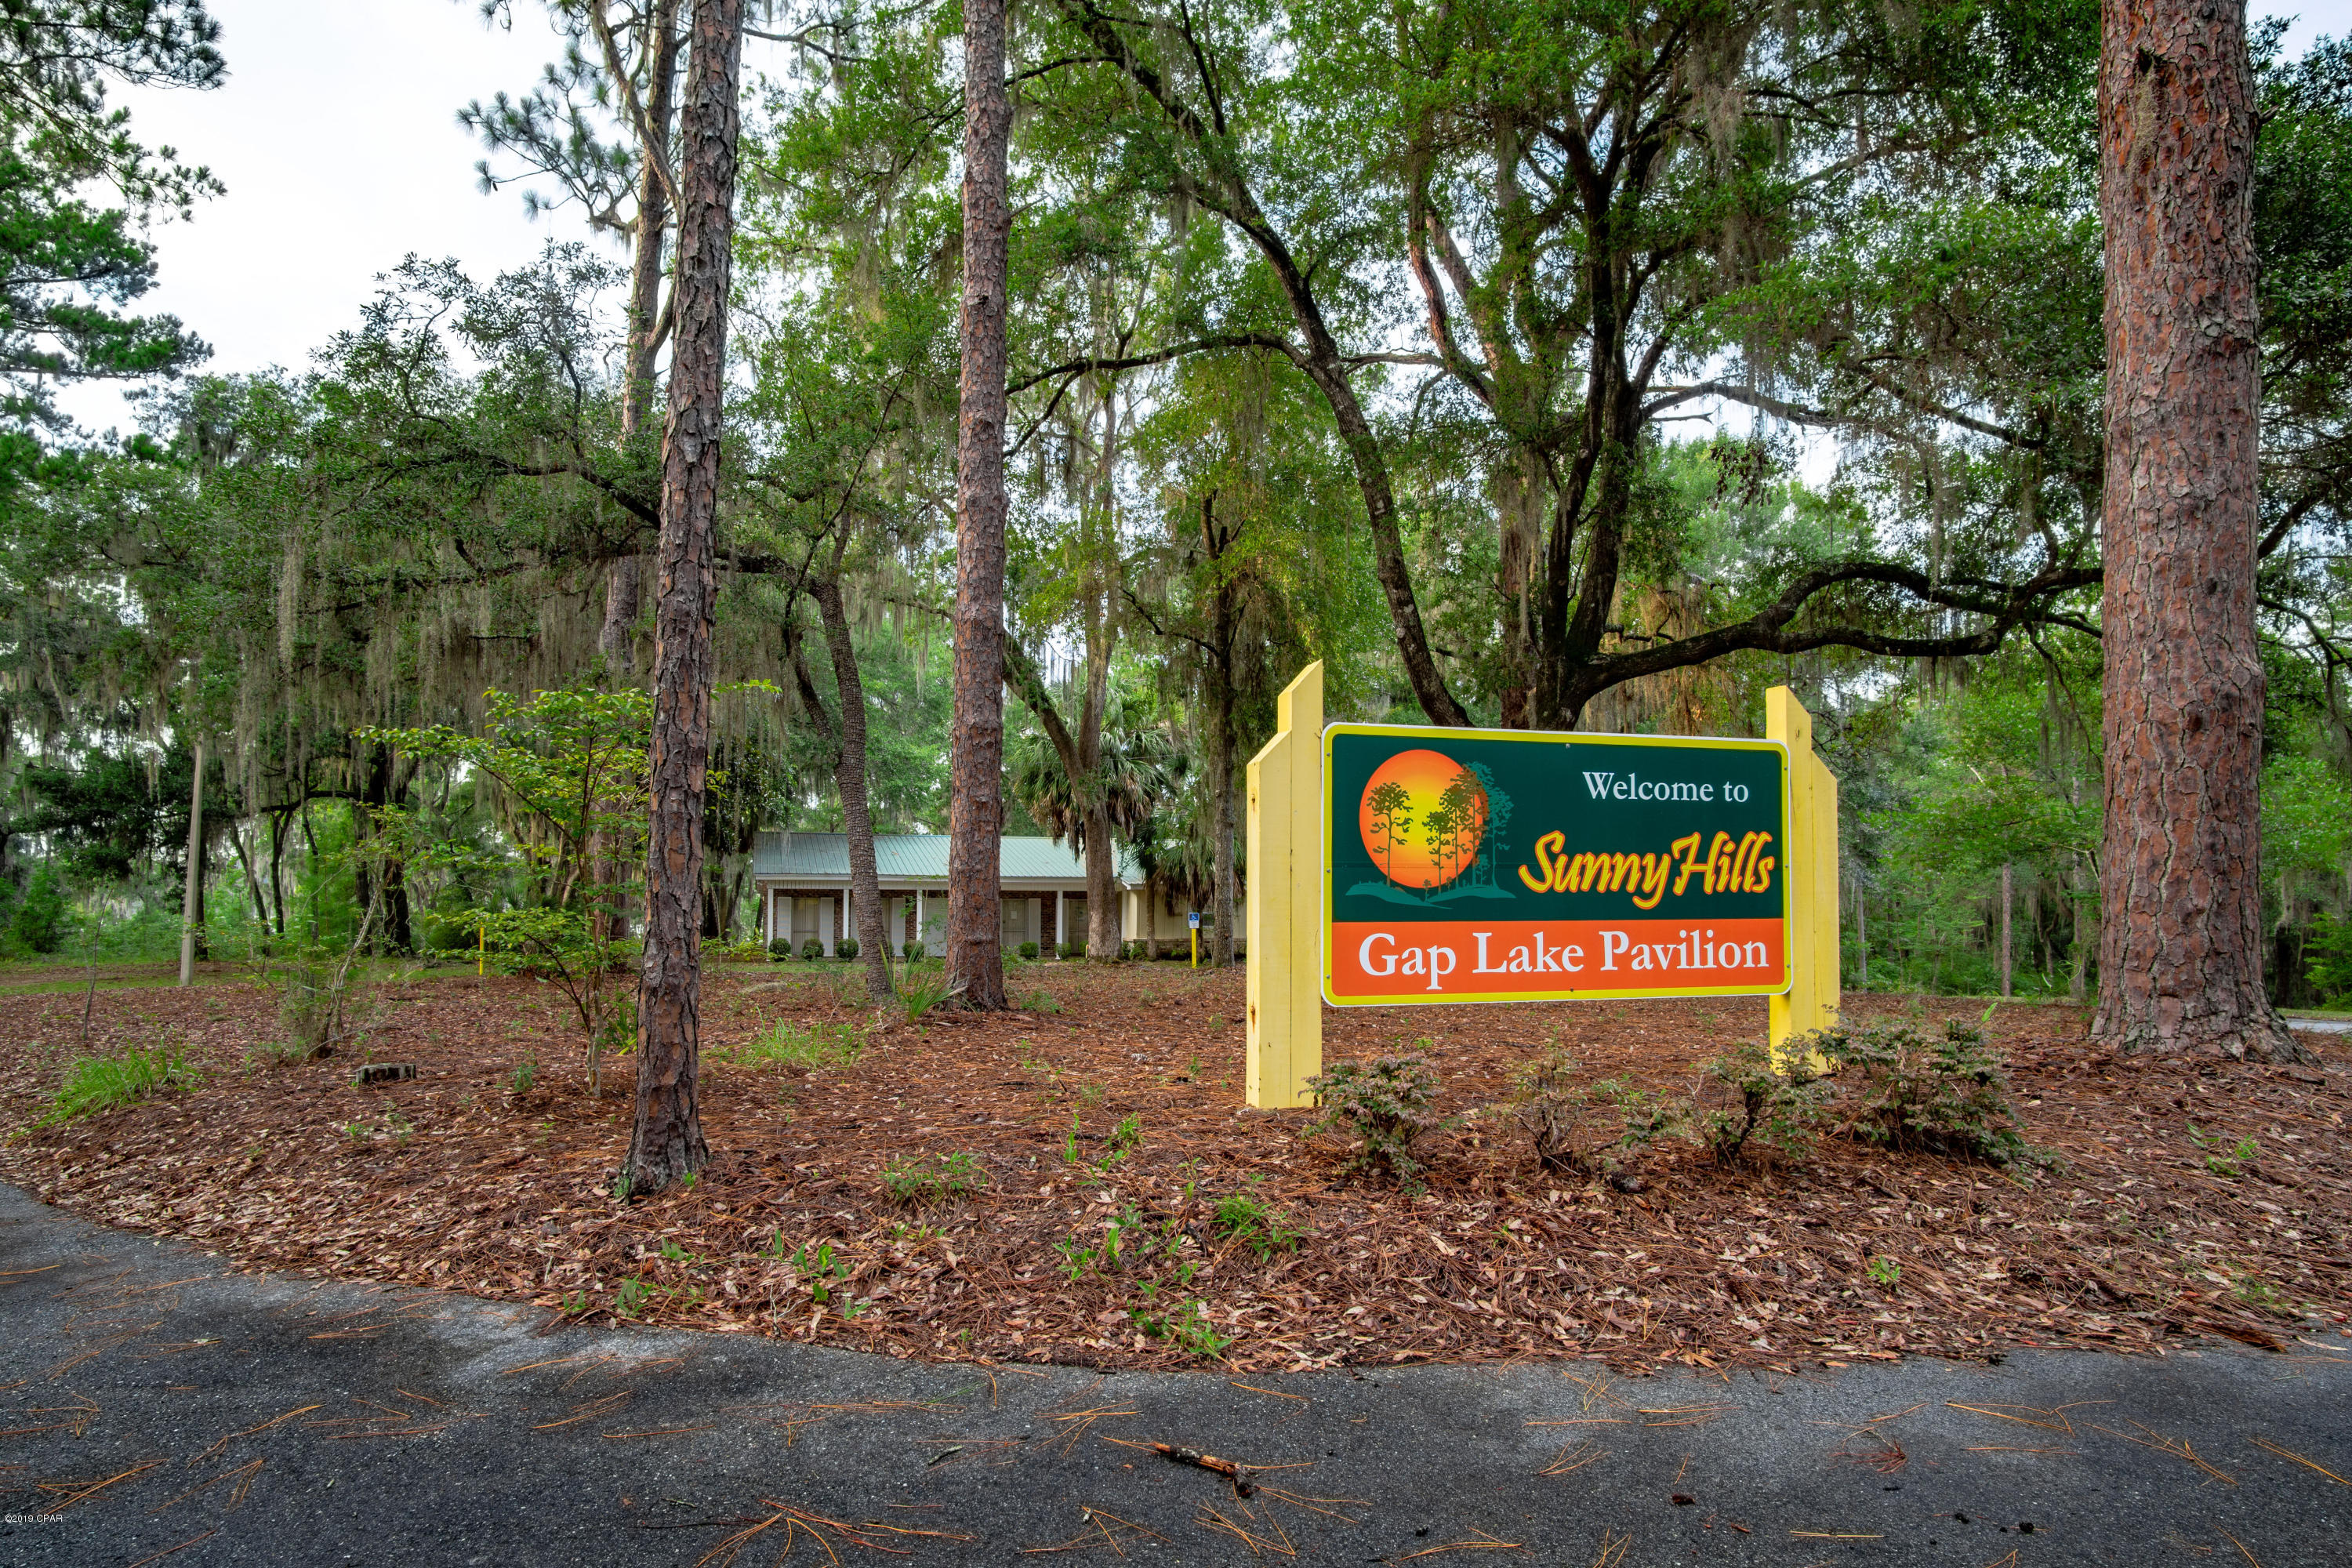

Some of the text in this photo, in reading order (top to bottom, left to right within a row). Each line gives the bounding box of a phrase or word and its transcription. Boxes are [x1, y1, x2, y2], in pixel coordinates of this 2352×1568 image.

[1582, 771, 1749, 803] Welcome to
[1518, 830, 1774, 910] Sunny Hills
[1359, 928, 1769, 990] Gap Lake Pavilion
